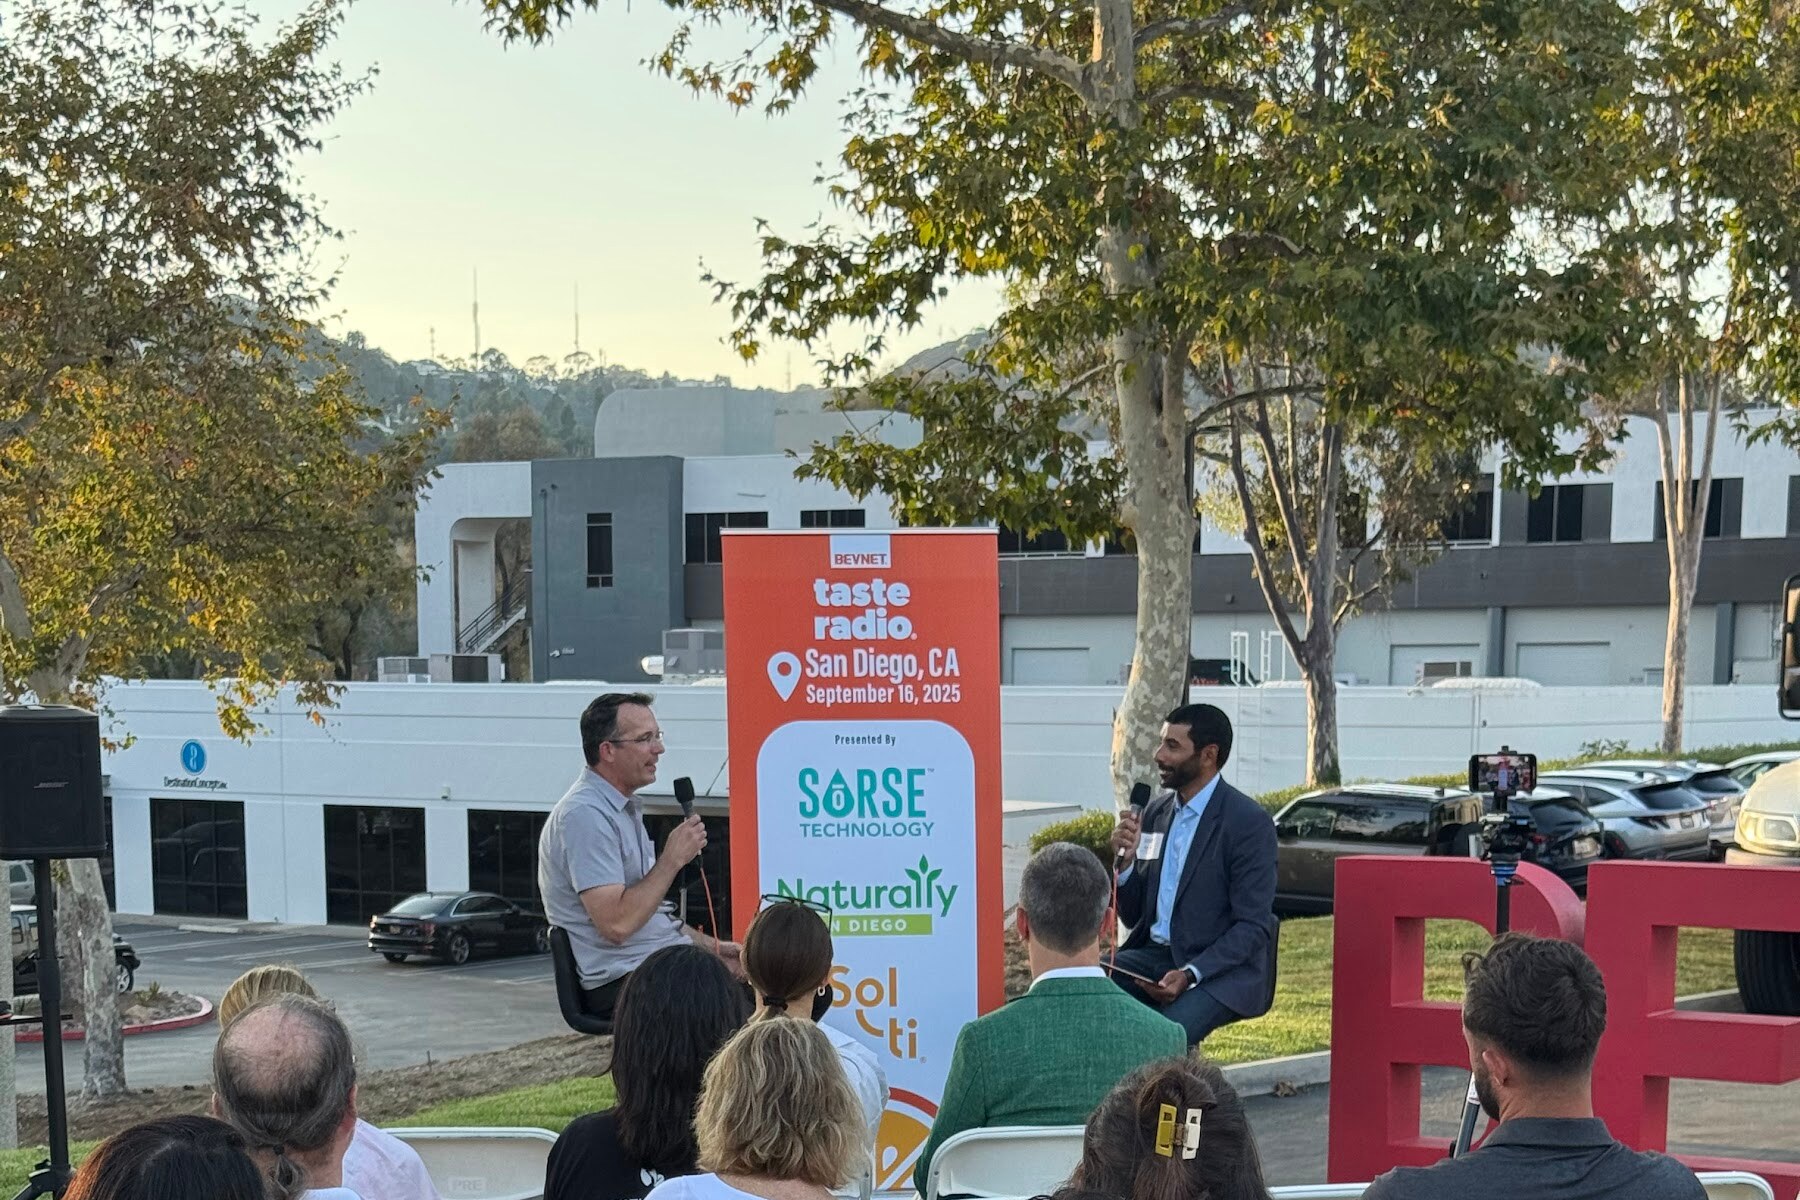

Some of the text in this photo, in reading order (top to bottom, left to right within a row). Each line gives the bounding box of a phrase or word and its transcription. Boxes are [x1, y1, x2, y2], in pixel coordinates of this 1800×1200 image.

[834, 553, 887, 565] BEVNET
[813, 578, 911, 607] taste
[805, 647, 960, 684] San Diego, CA
[806, 683, 961, 707] September 16, 2025
[835, 734, 896, 746] Presented By
[800, 822, 935, 838] TECHNOLOGY
[777, 866, 959, 917] Naturally
[849, 919, 907, 932] DIEGO
[828, 965, 898, 1007] Sol
